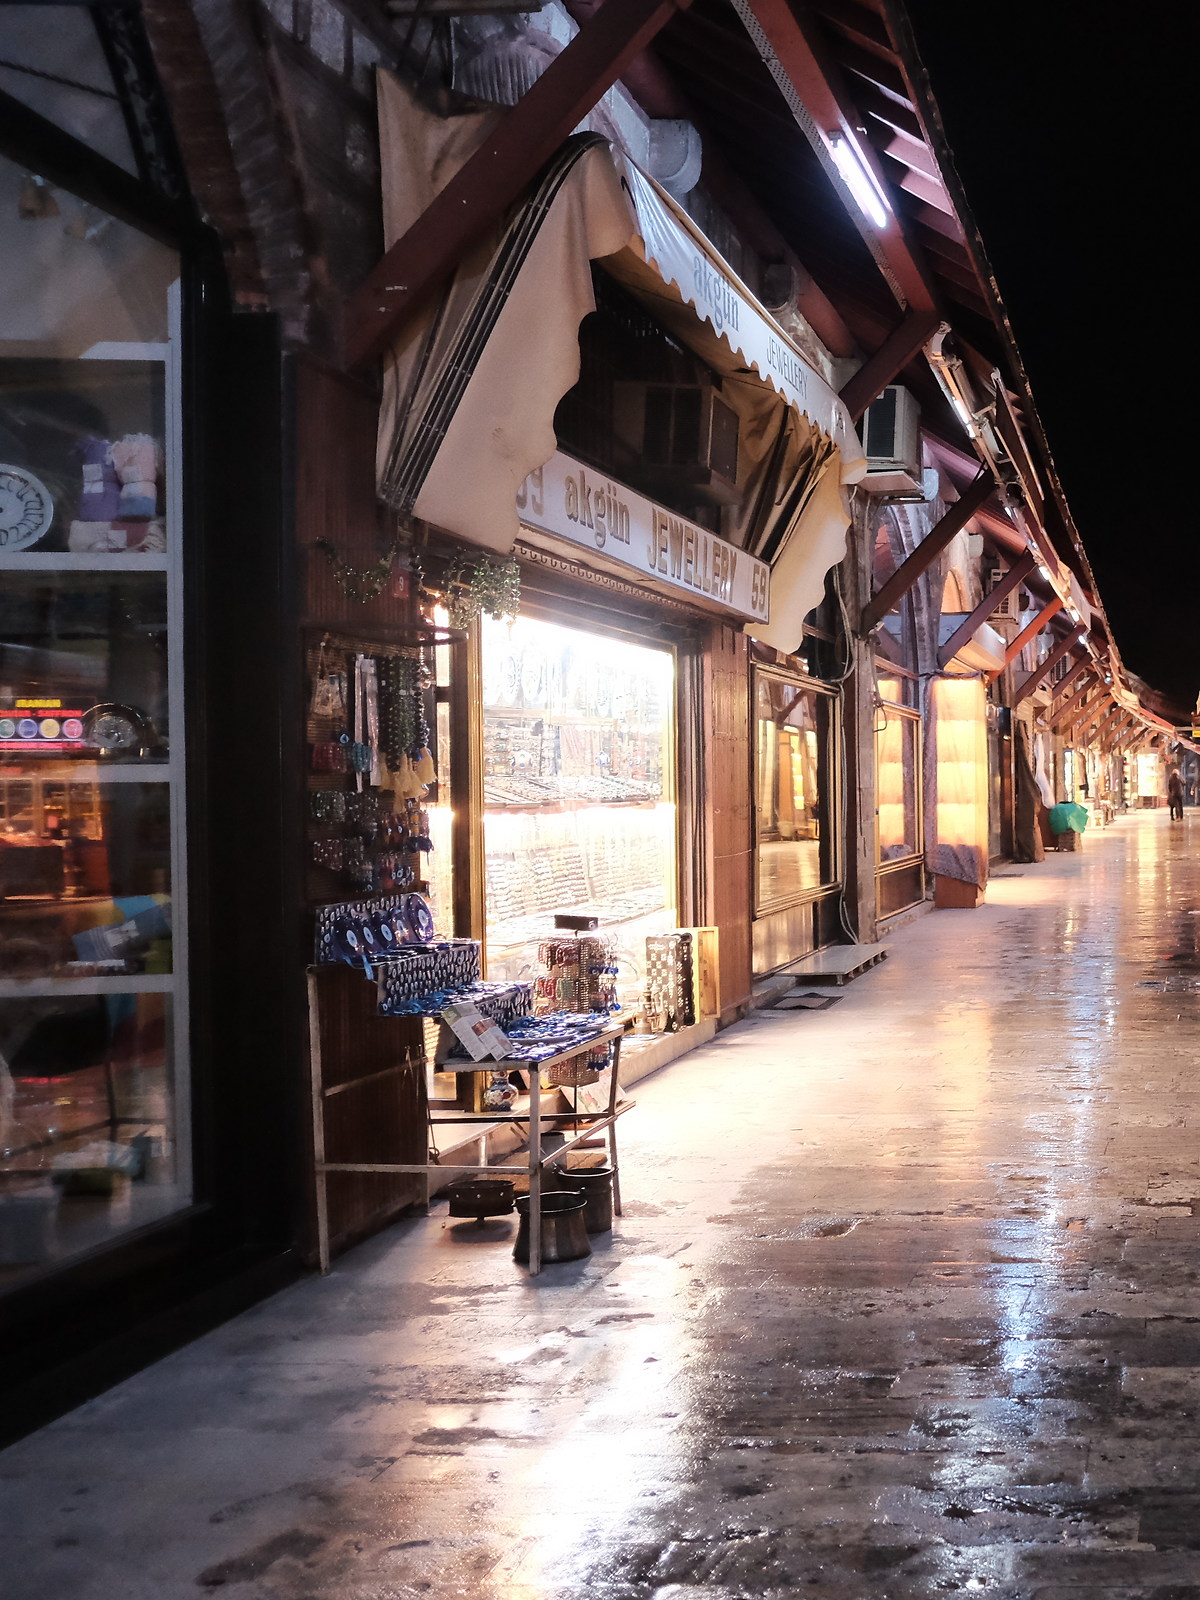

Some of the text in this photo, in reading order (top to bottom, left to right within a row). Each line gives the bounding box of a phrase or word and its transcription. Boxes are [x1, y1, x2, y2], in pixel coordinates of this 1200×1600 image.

[693, 252, 808, 400] akgün JEWELLERY
[564, 470, 631, 548] akgün
[646, 507, 738, 603] JEWELLERY
[751, 563, 767, 613] 59
